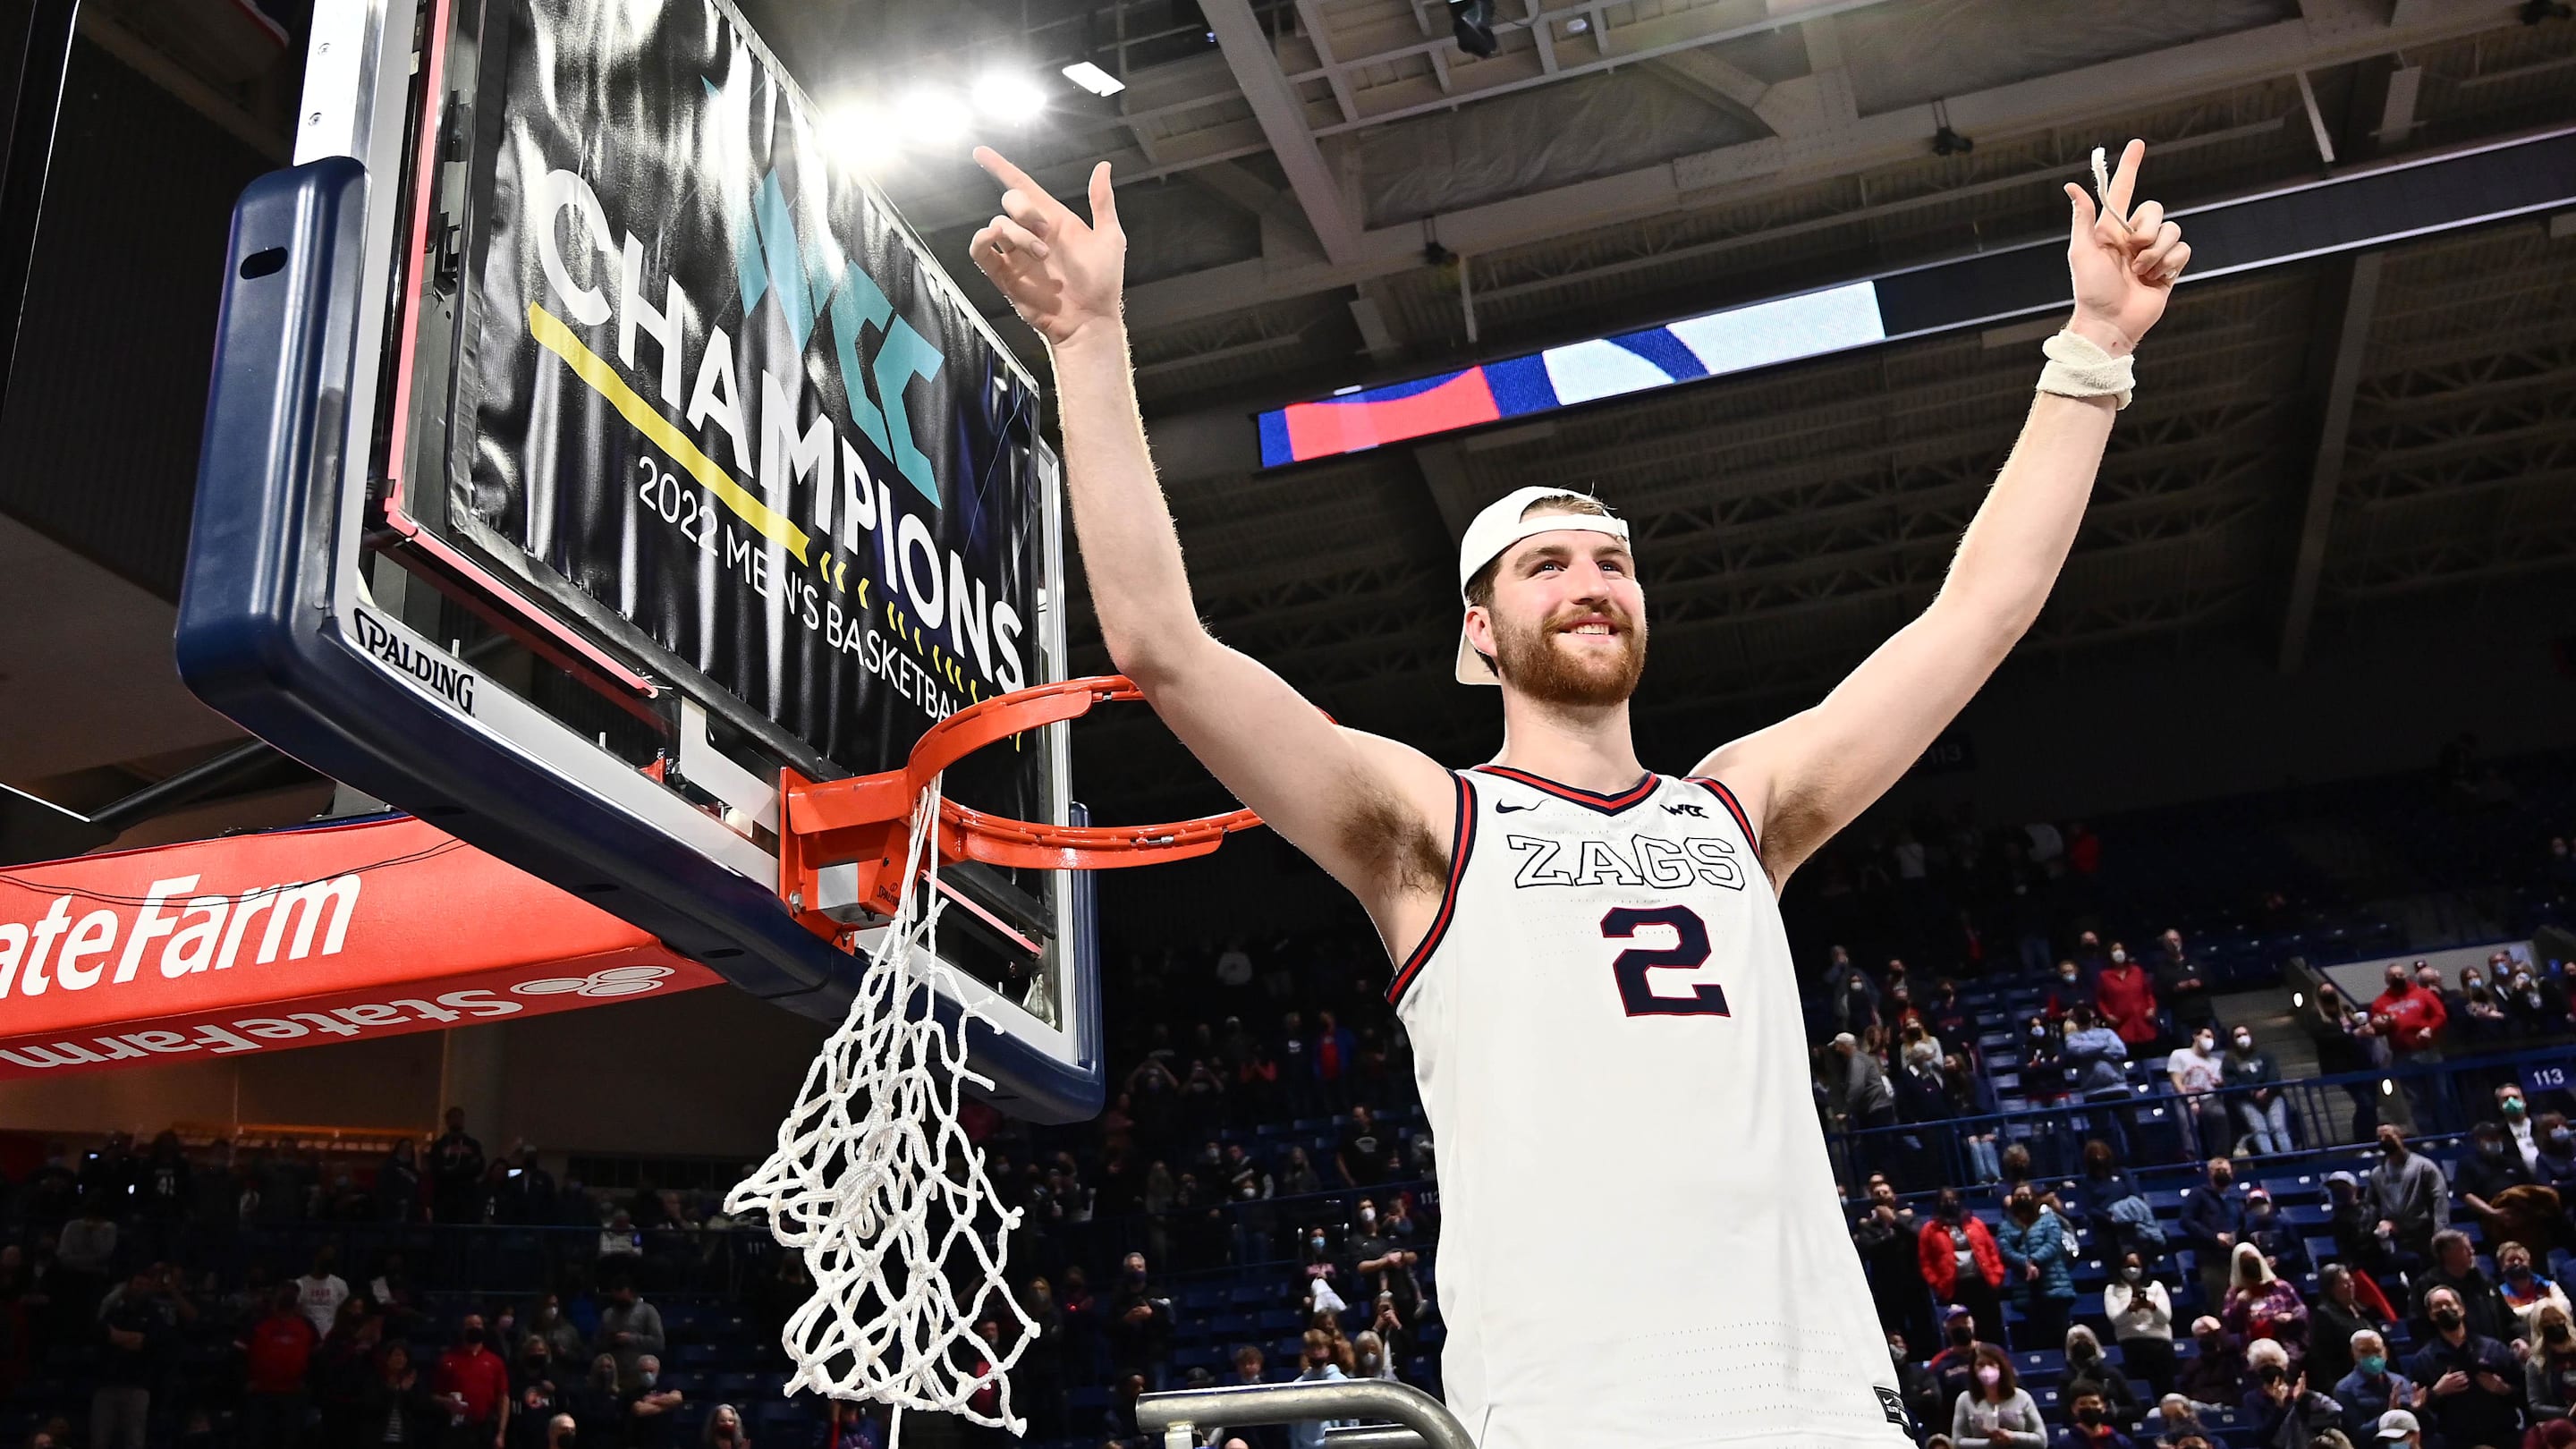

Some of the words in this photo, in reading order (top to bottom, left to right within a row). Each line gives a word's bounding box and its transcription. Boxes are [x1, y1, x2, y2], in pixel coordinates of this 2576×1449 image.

[537, 168, 1025, 694] CHAMPIONS
[639, 455, 719, 557] 2022
[726, 523, 820, 631] MEN'S
[826, 600, 959, 724] BASKETBA
[353, 607, 475, 717] SPALDING
[1507, 834, 1746, 892] ZAGS
[1599, 904, 1732, 1018] 2
[2533, 1067, 2565, 1088] 113
